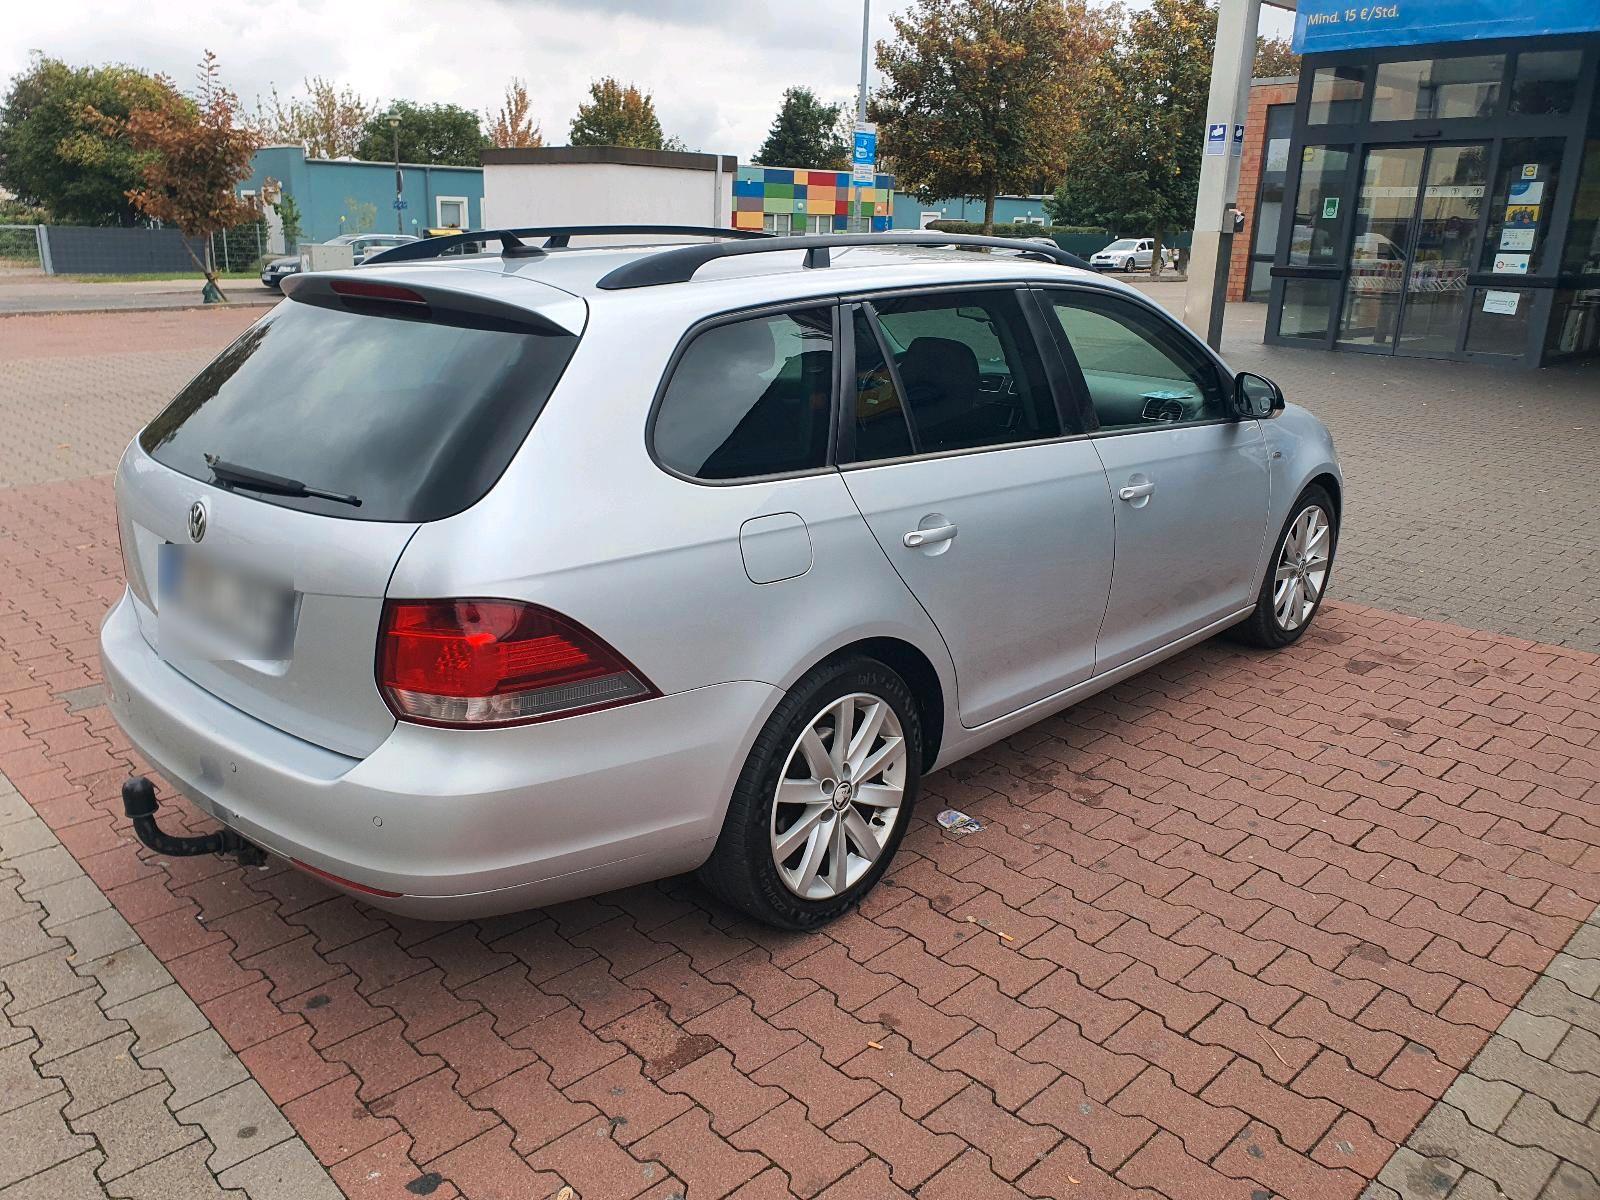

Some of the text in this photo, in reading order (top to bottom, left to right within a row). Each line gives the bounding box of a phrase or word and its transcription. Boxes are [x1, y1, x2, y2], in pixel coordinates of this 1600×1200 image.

[1307, 5, 1399, 26] Mind. 15 €/Std.
